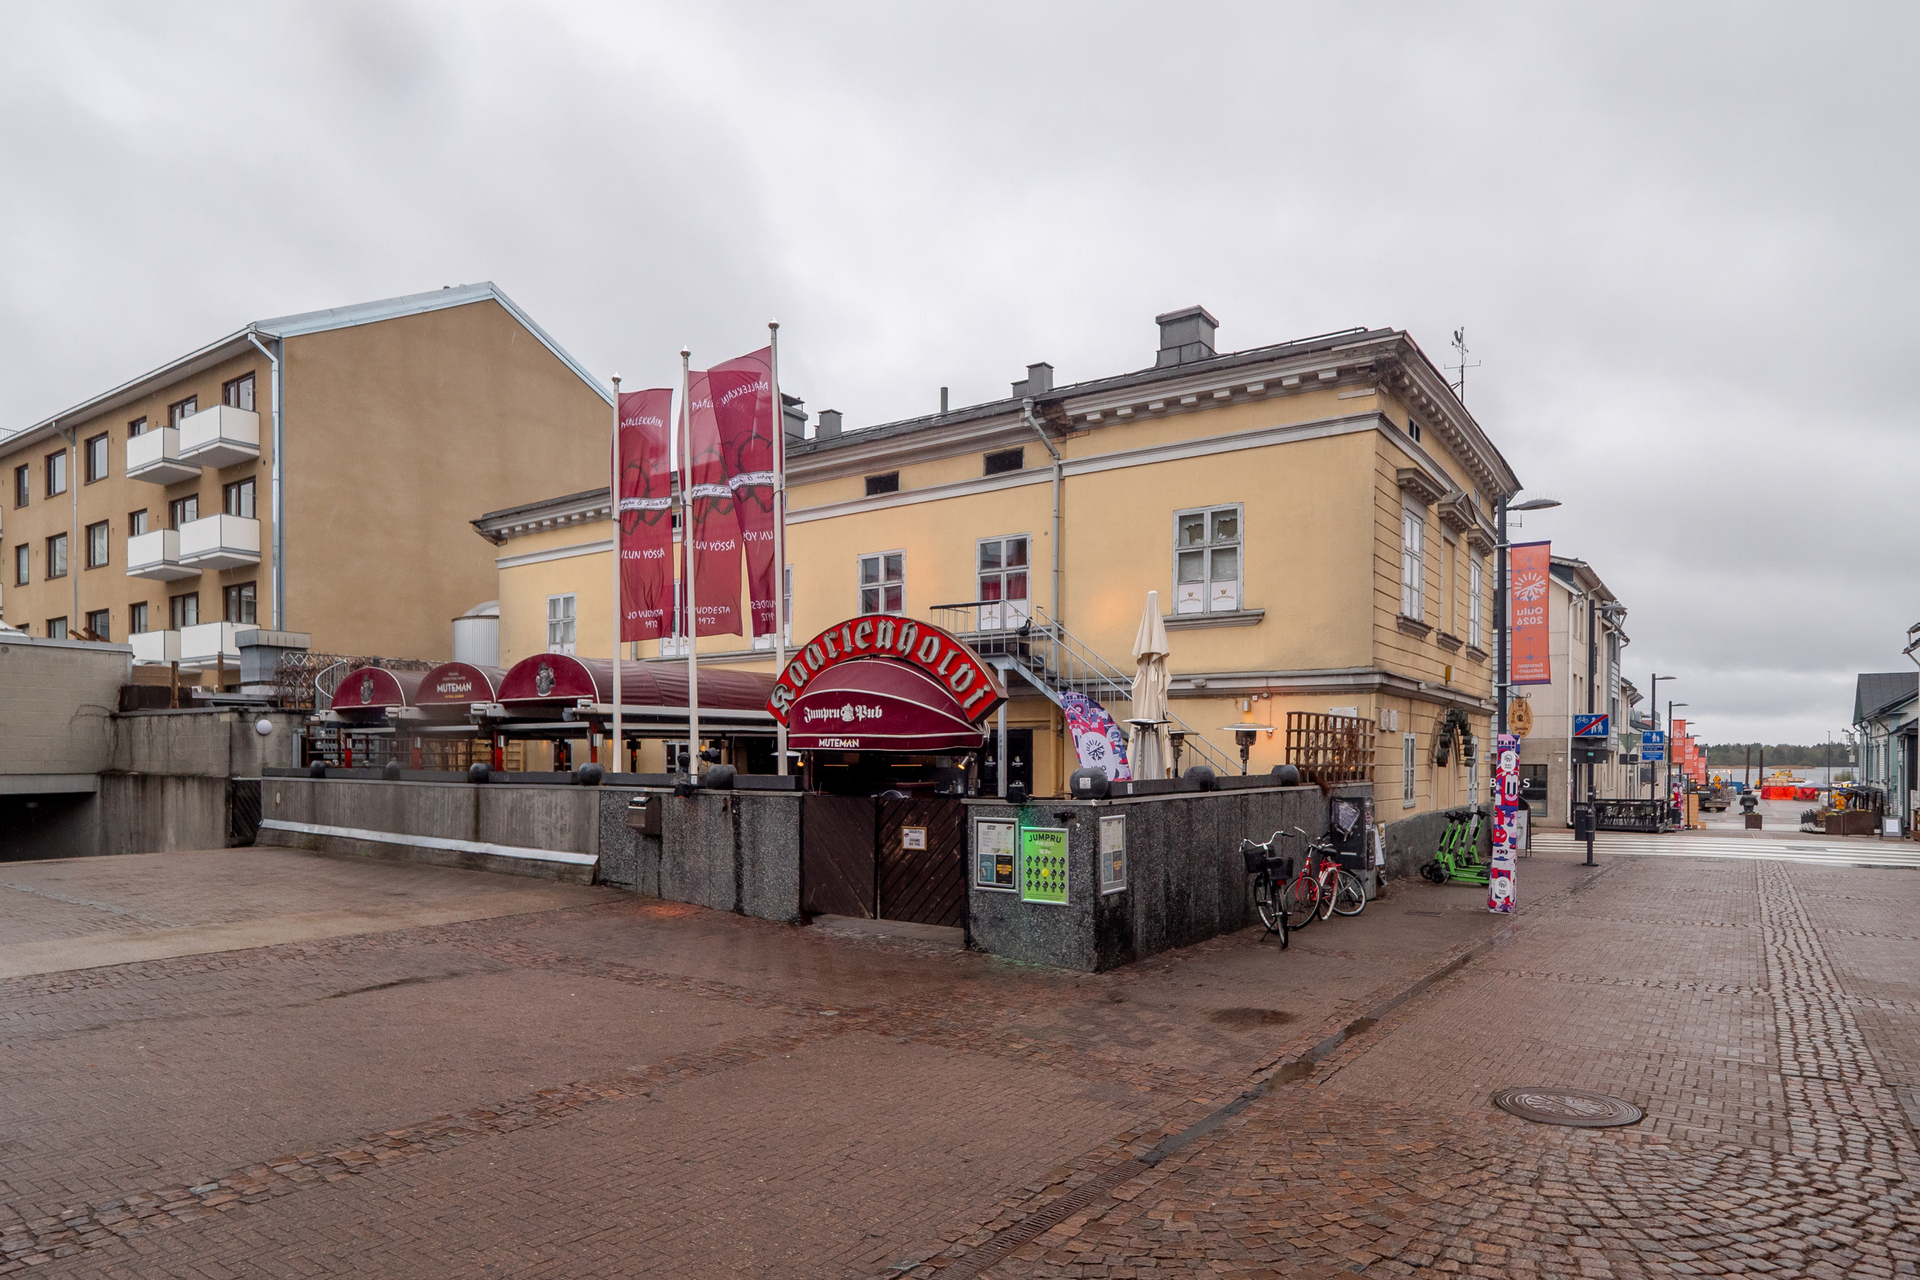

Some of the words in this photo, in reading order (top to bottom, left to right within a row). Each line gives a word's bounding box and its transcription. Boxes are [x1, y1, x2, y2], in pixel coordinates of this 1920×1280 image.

[709, 539, 736, 551] YÖSSÄ
[643, 548, 665, 559] YÖSSÄ
[697, 617, 716, 625] 1972
[437, 682, 472, 693] MUTEMAN
[804, 706, 840, 723] Jumpru
[855, 704, 883, 722] Pub
[818, 738, 860, 748] MUTEMAN
[1028, 833, 1062, 843] JUMPRU
